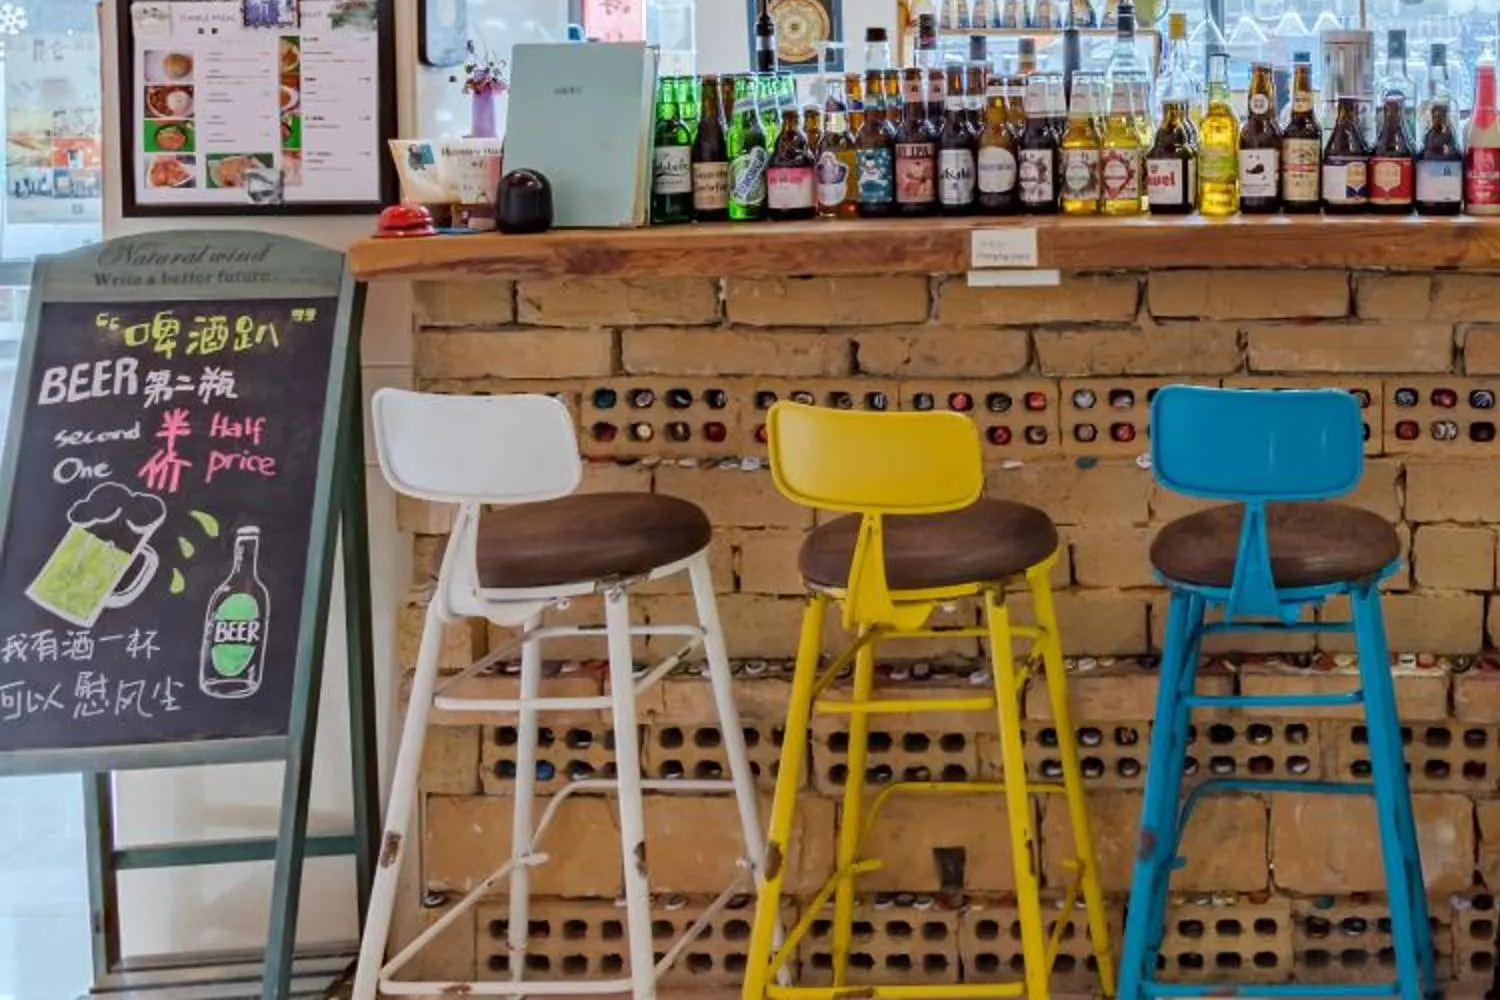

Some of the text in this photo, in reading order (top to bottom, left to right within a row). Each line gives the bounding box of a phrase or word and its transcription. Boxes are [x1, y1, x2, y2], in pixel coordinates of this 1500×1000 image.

[160, 269, 213, 285] better
[38, 356, 140, 406] BEER
[53, 422, 141, 448] second
[210, 412, 267, 446] Half
[53, 456, 112, 484] One
[206, 451, 278, 484] price
[0, 628, 162, 664] 我有酒一杯
[215, 620, 261, 643] BEER
